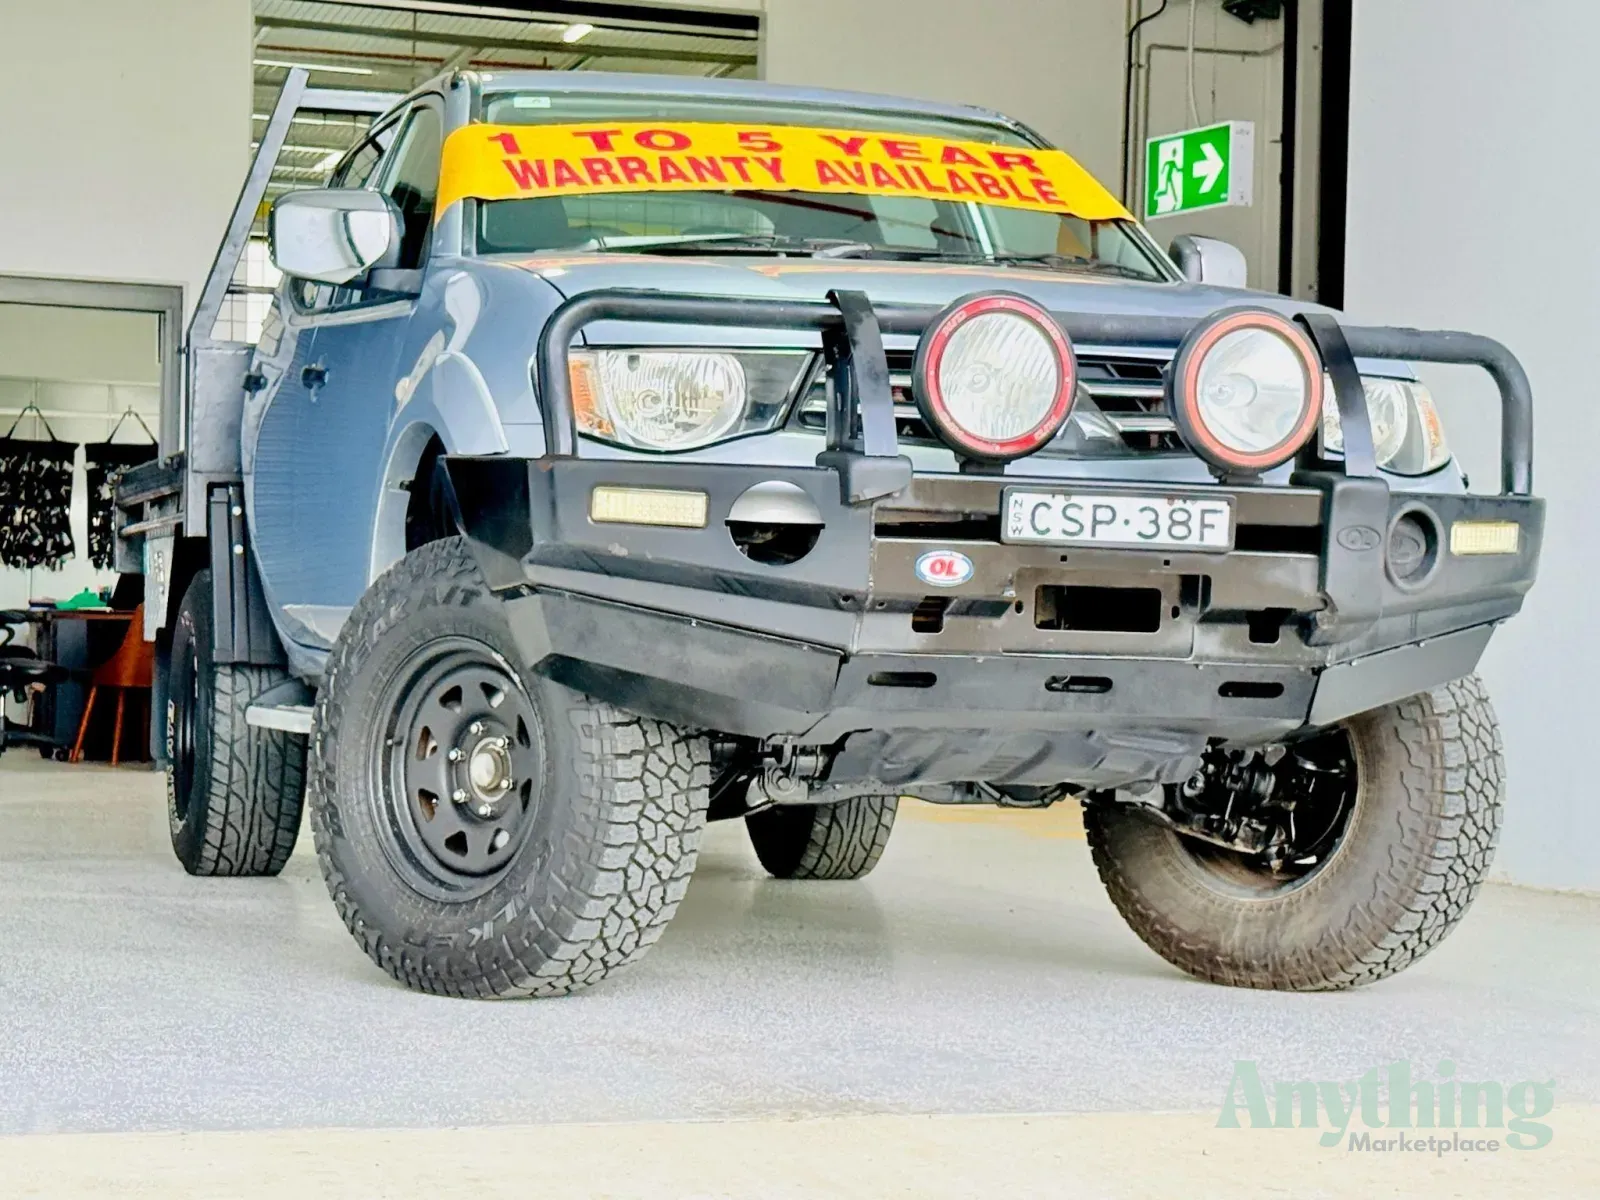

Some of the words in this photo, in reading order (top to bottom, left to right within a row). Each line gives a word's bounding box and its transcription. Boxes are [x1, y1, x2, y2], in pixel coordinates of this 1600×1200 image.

[488, 132, 521, 154] 1
[572, 129, 692, 152] TO
[737, 131, 783, 152] 5
[817, 134, 1043, 175] YEAR
[502, 156, 785, 190] WARRANTY
[815, 159, 1068, 206] AVAILABLE
[929, 558, 958, 576] OL
